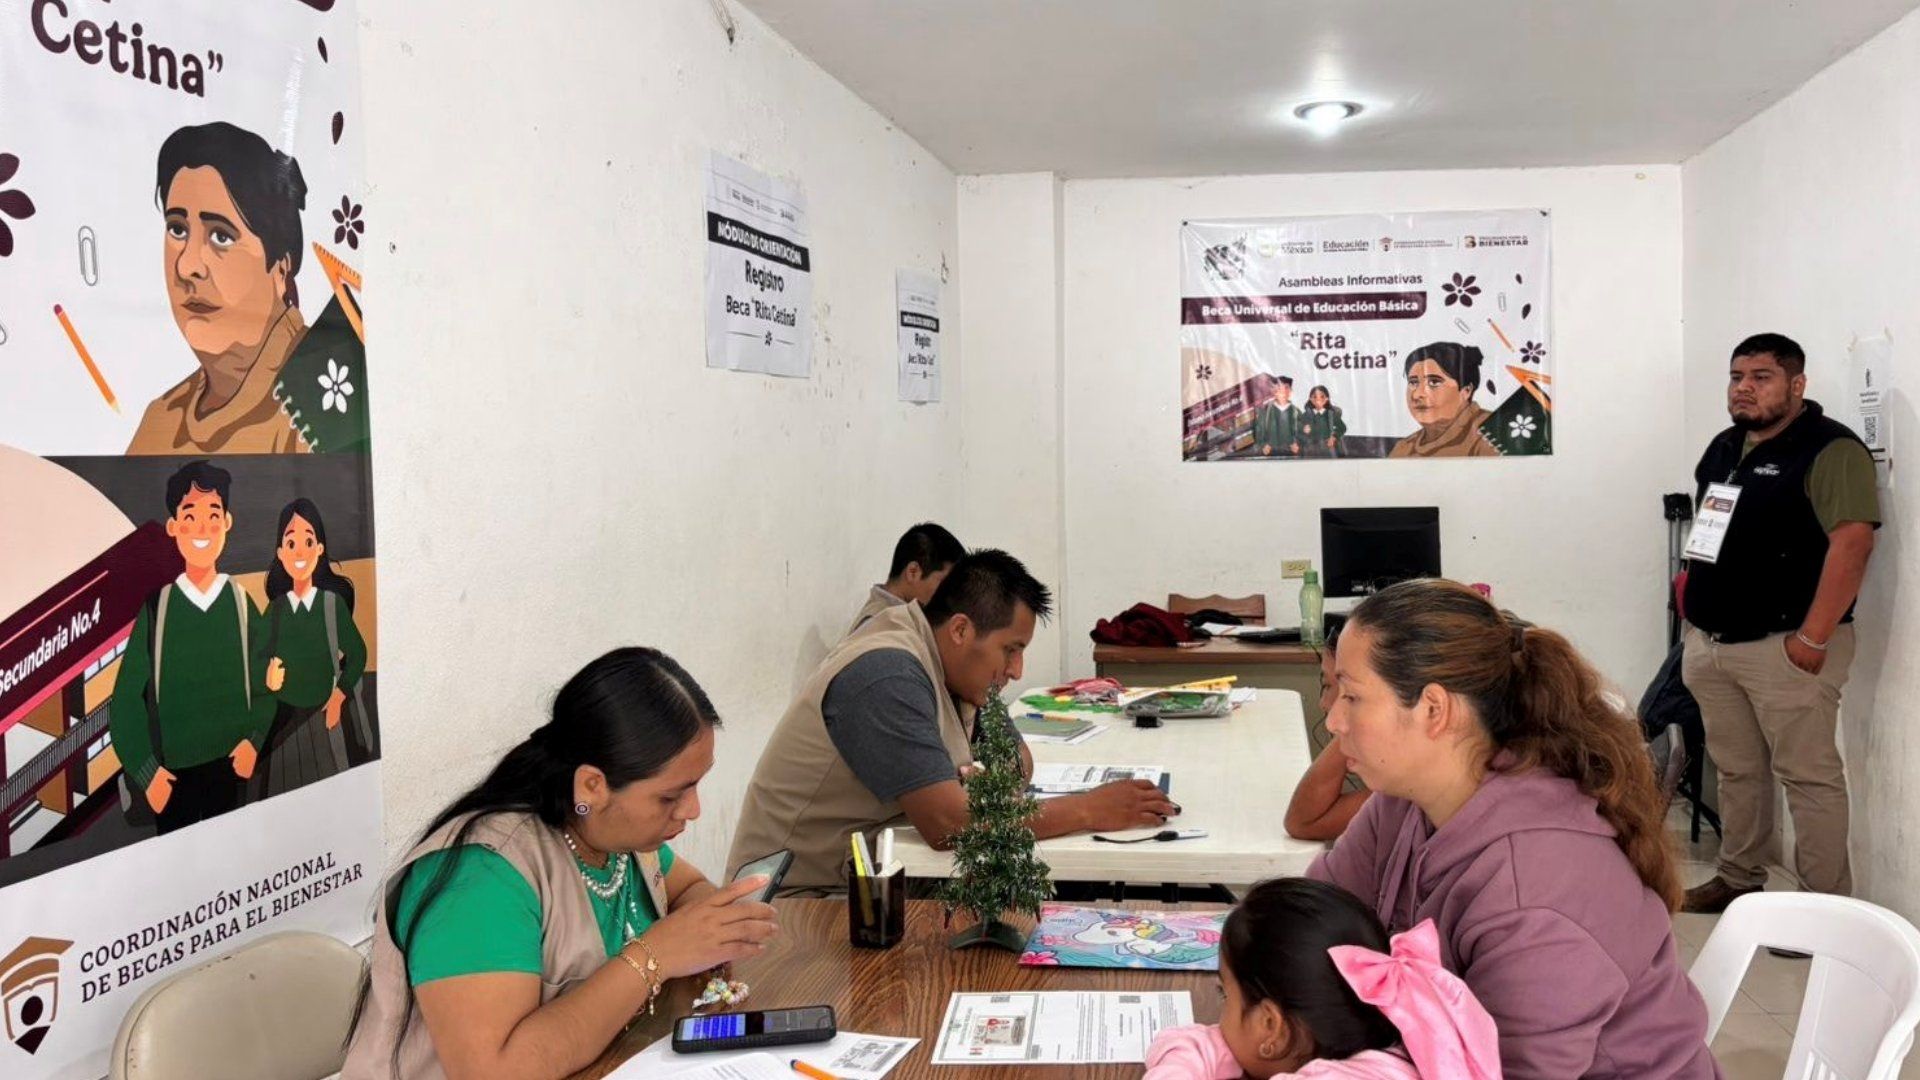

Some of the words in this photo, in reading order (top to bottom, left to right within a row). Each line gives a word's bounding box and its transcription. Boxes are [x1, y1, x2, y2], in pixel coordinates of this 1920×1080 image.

[31, 0, 223, 97] Cetina”
[1323, 239, 1369, 249] Educación
[745, 260, 784, 292] Registro
[1279, 275, 1344, 287] Asambleas
[1347, 274, 1423, 286] Informativas
[726, 295, 750, 316] Beca
[1202, 305, 1231, 316] Beca
[1234, 303, 1291, 316] Universal
[1294, 303, 1310, 314] de
[1313, 301, 1376, 313] Educación
[1379, 299, 1419, 311] Básica
[80, 890, 243, 973] COORDINACIÓN
[247, 852, 336, 903] NACIONAL
[82, 973, 111, 1002] DE
[118, 942, 185, 987] BECAS
[190, 918, 241, 954] PARA
[246, 906, 267, 929] EL
[272, 863, 363, 917] BIENESTAR
